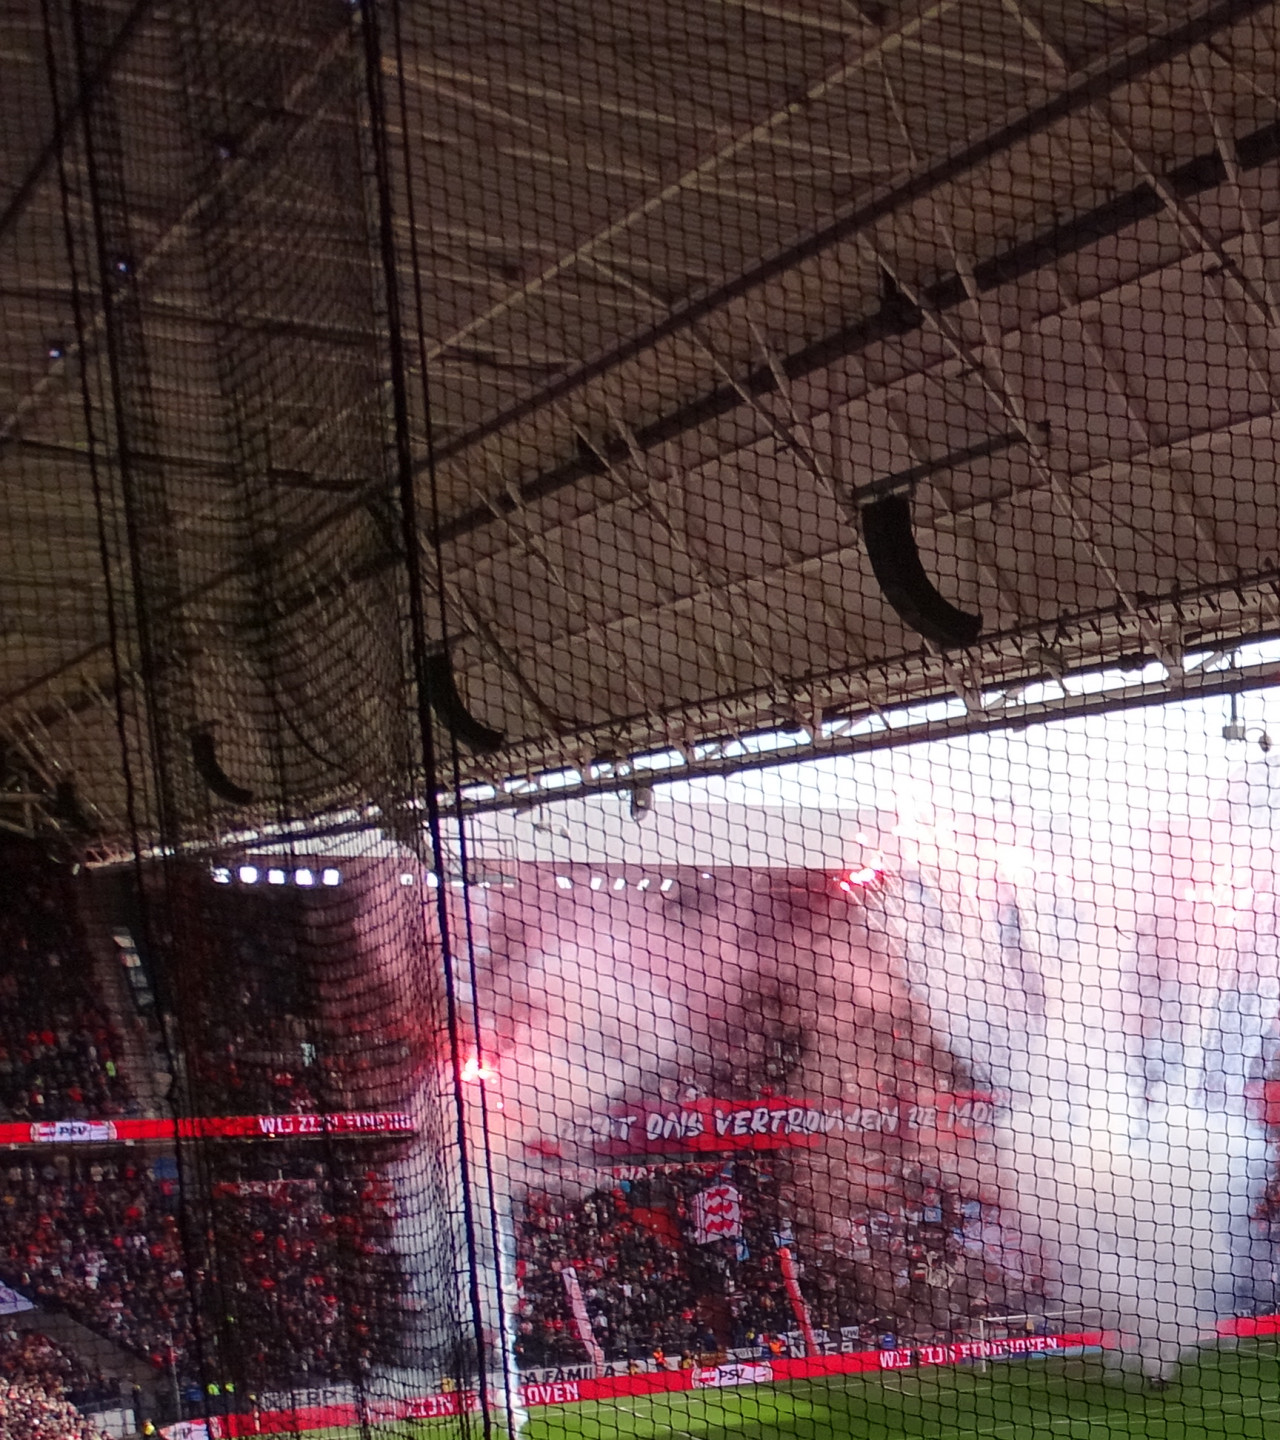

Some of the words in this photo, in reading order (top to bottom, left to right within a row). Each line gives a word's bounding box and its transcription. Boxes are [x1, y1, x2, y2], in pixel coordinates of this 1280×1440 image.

[59, 1126, 88, 1137] PSV
[259, 1117, 293, 1134] WIJ
[646, 1112, 703, 1140] ONS
[715, 1106, 899, 1136] VERTROUWEN
[880, 1350, 911, 1368] WIJ
[919, 1347, 957, 1365] ZIJN
[960, 1337, 1058, 1358] EINDHOVEN
[719, 1368, 747, 1381] PSV
